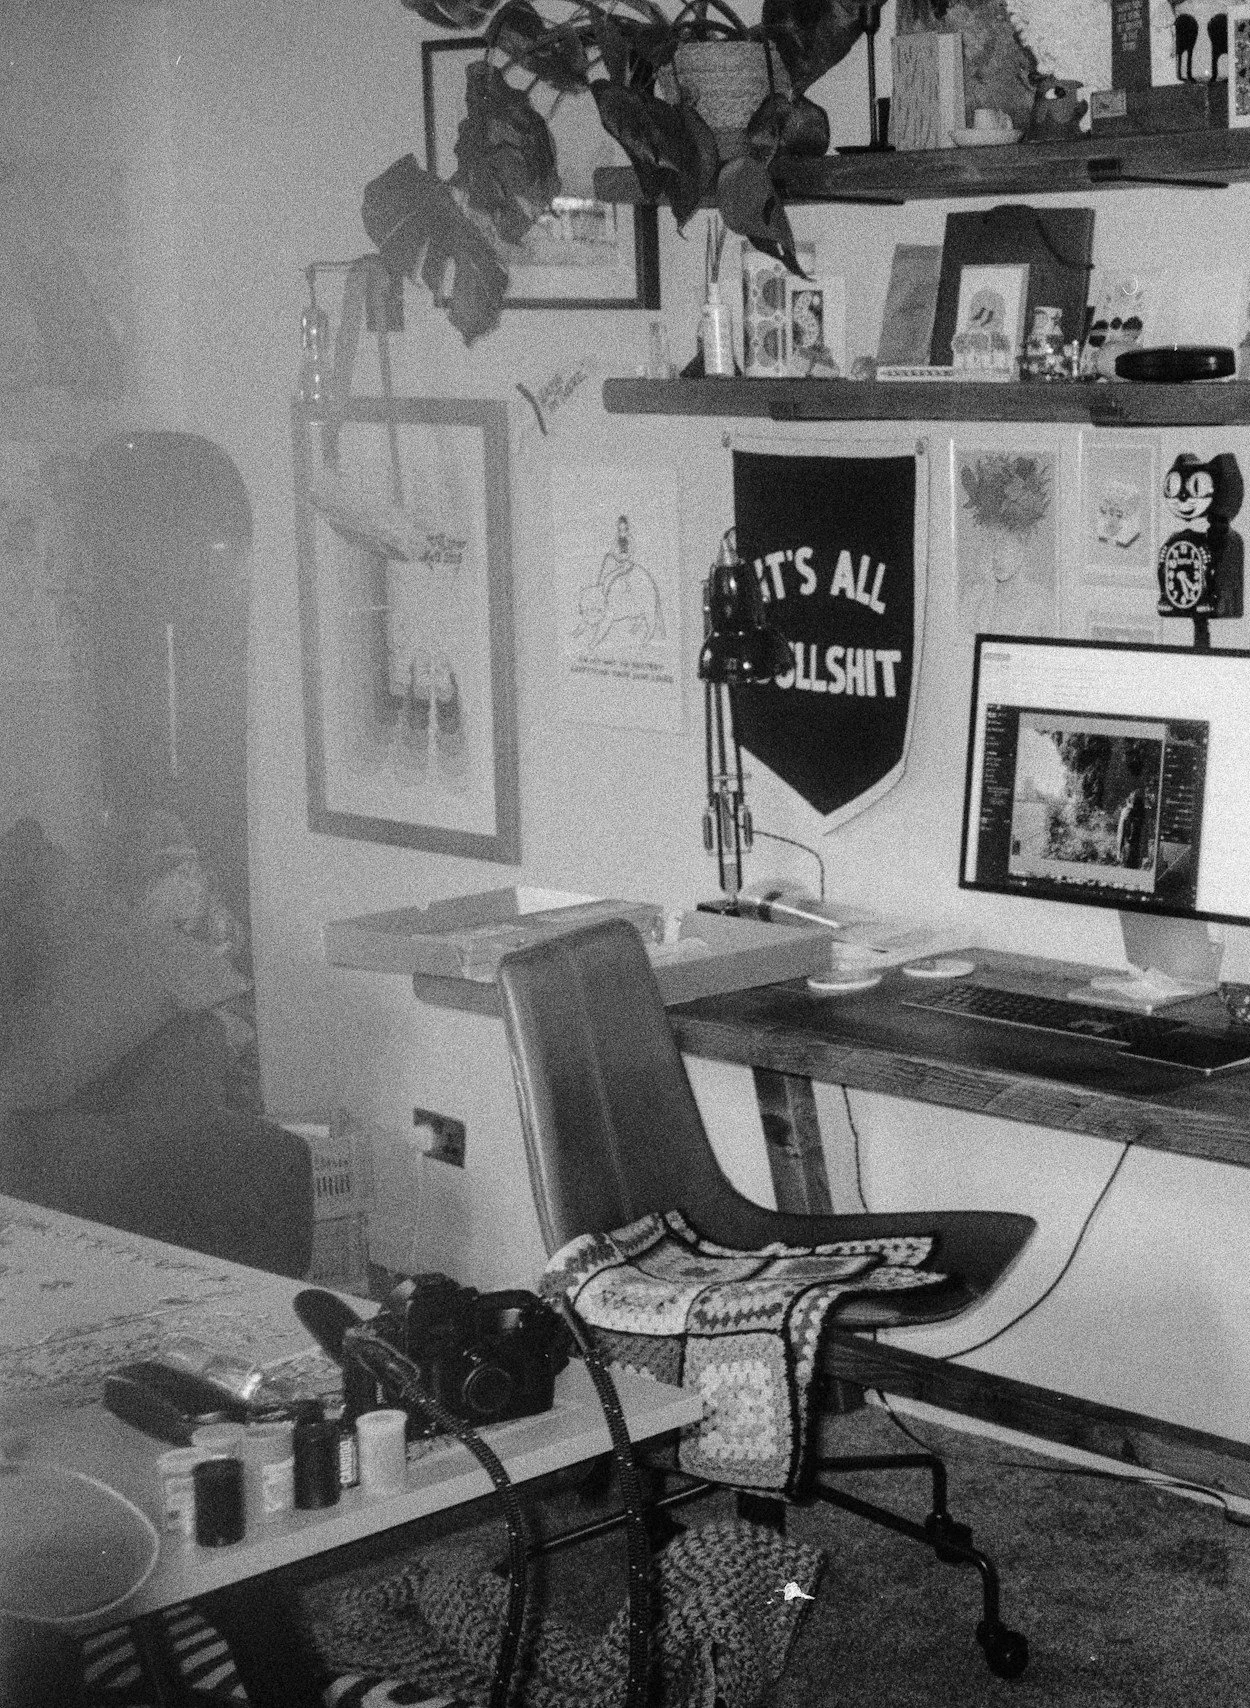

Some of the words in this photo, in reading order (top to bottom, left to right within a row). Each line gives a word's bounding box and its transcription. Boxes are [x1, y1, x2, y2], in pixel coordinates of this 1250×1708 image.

[753, 546, 817, 603] IT'S
[830, 550, 886, 615] ALL
[756, 641, 902, 697] LLSHIT
